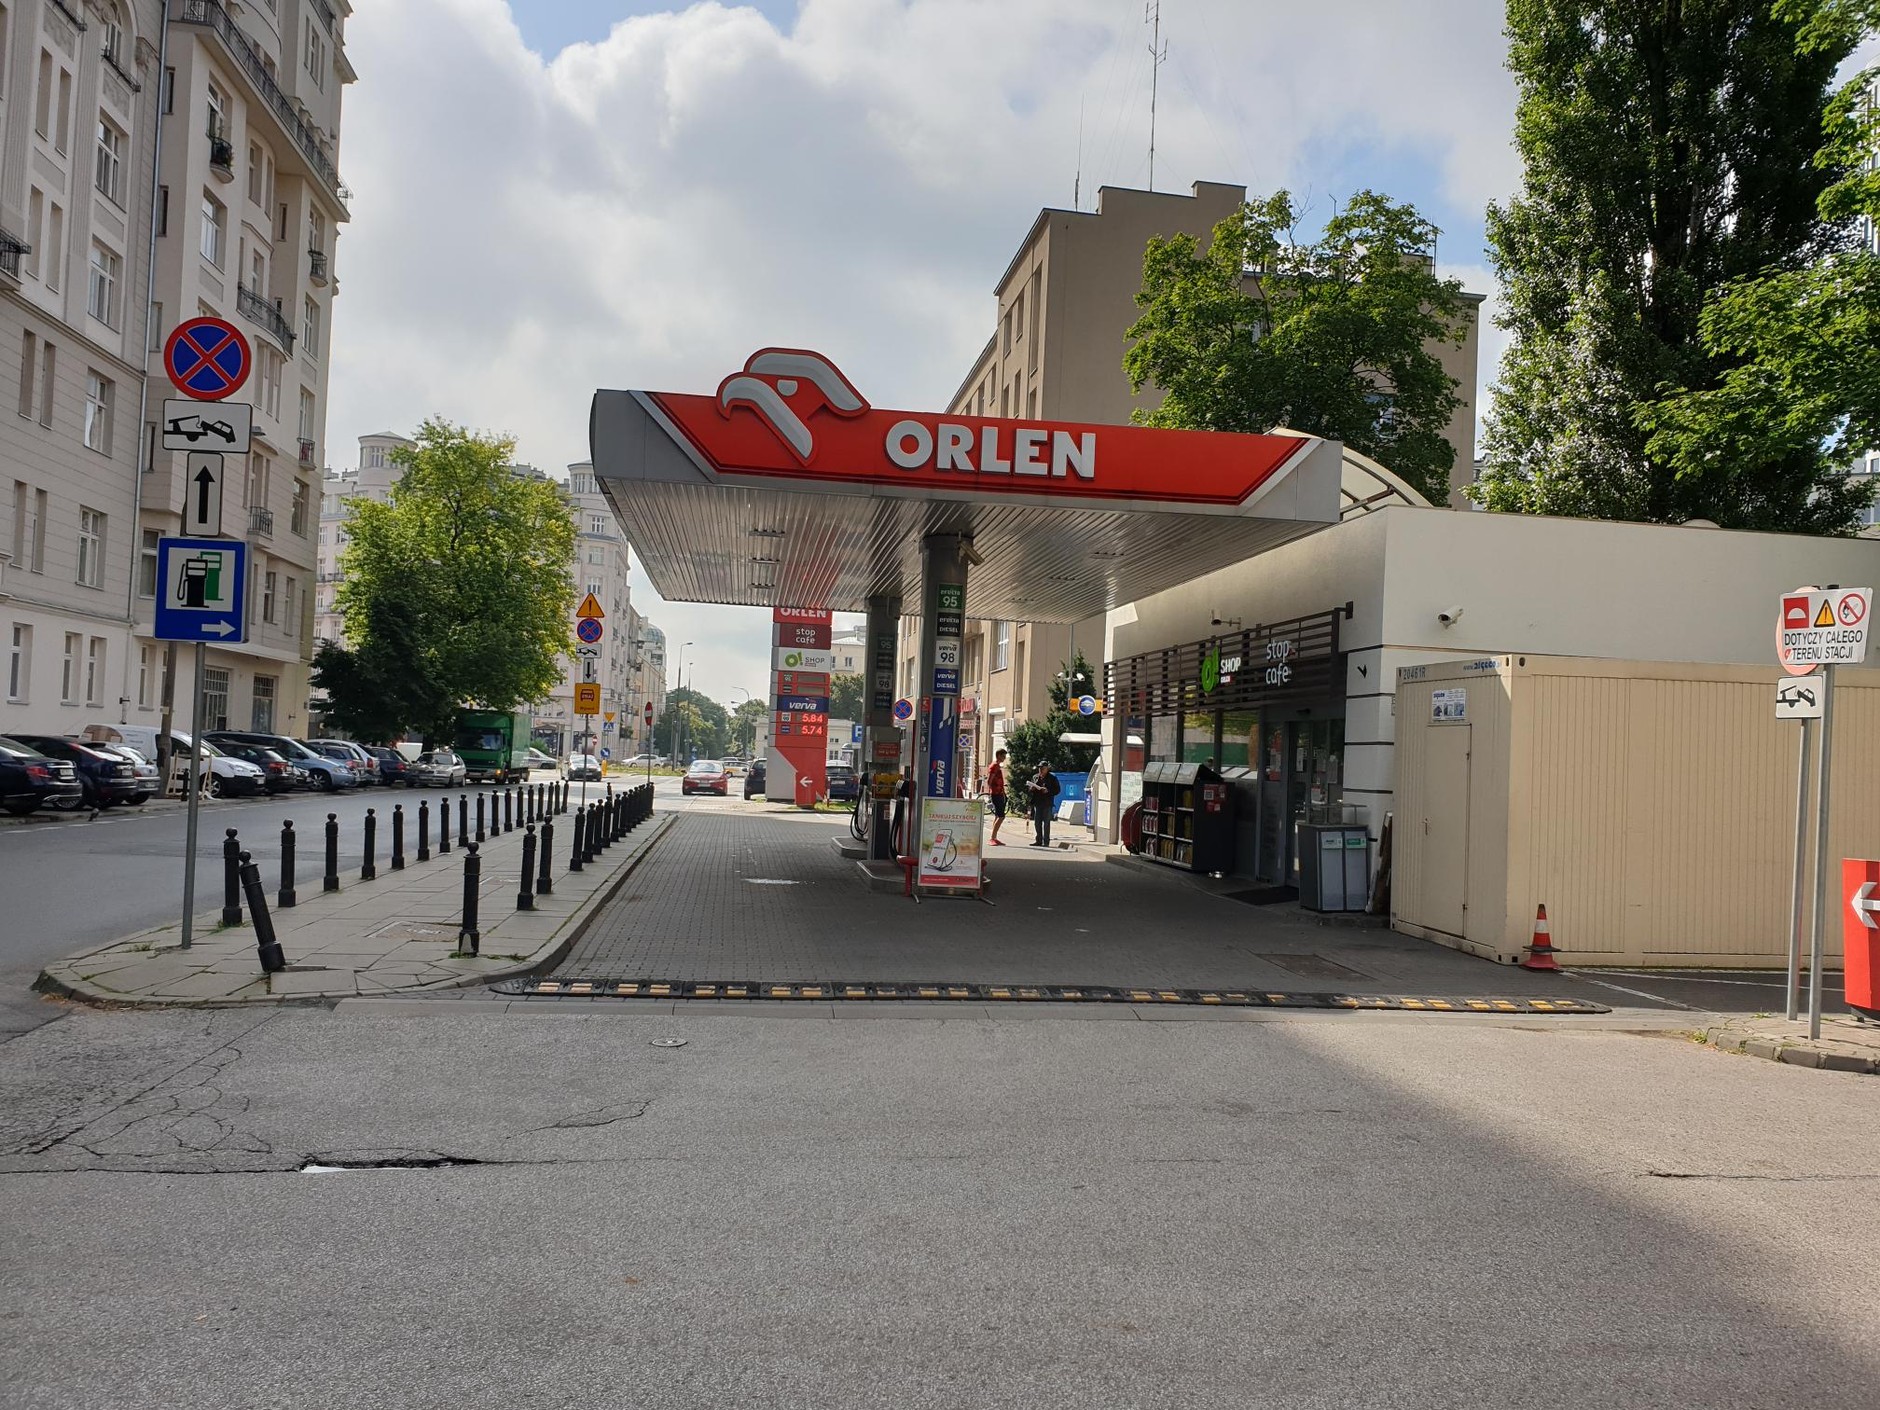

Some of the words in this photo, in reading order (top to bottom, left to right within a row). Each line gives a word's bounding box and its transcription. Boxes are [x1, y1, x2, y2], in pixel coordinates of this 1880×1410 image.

[885, 419, 1097, 480] ORLEN
[942, 595, 958, 607] 95
[795, 628, 816, 637] stop
[1784, 632, 1823, 645] DOTYCZY
[1826, 630, 1863, 644] CAŁEGO
[795, 636, 816, 644] cafe
[940, 651, 955, 663] 98
[1266, 639, 1290, 663] stop
[1792, 646, 1823, 660] TERENU
[1824, 645, 1854, 659] STACJI
[804, 656, 825, 664] SHOP
[1220, 656, 1241, 674] SHOP
[1265, 662, 1289, 687] cafe
[789, 701, 817, 710] verva
[801, 713, 823, 723] 5.84
[800, 725, 823, 735] 5.74
[935, 759, 946, 795] verva
